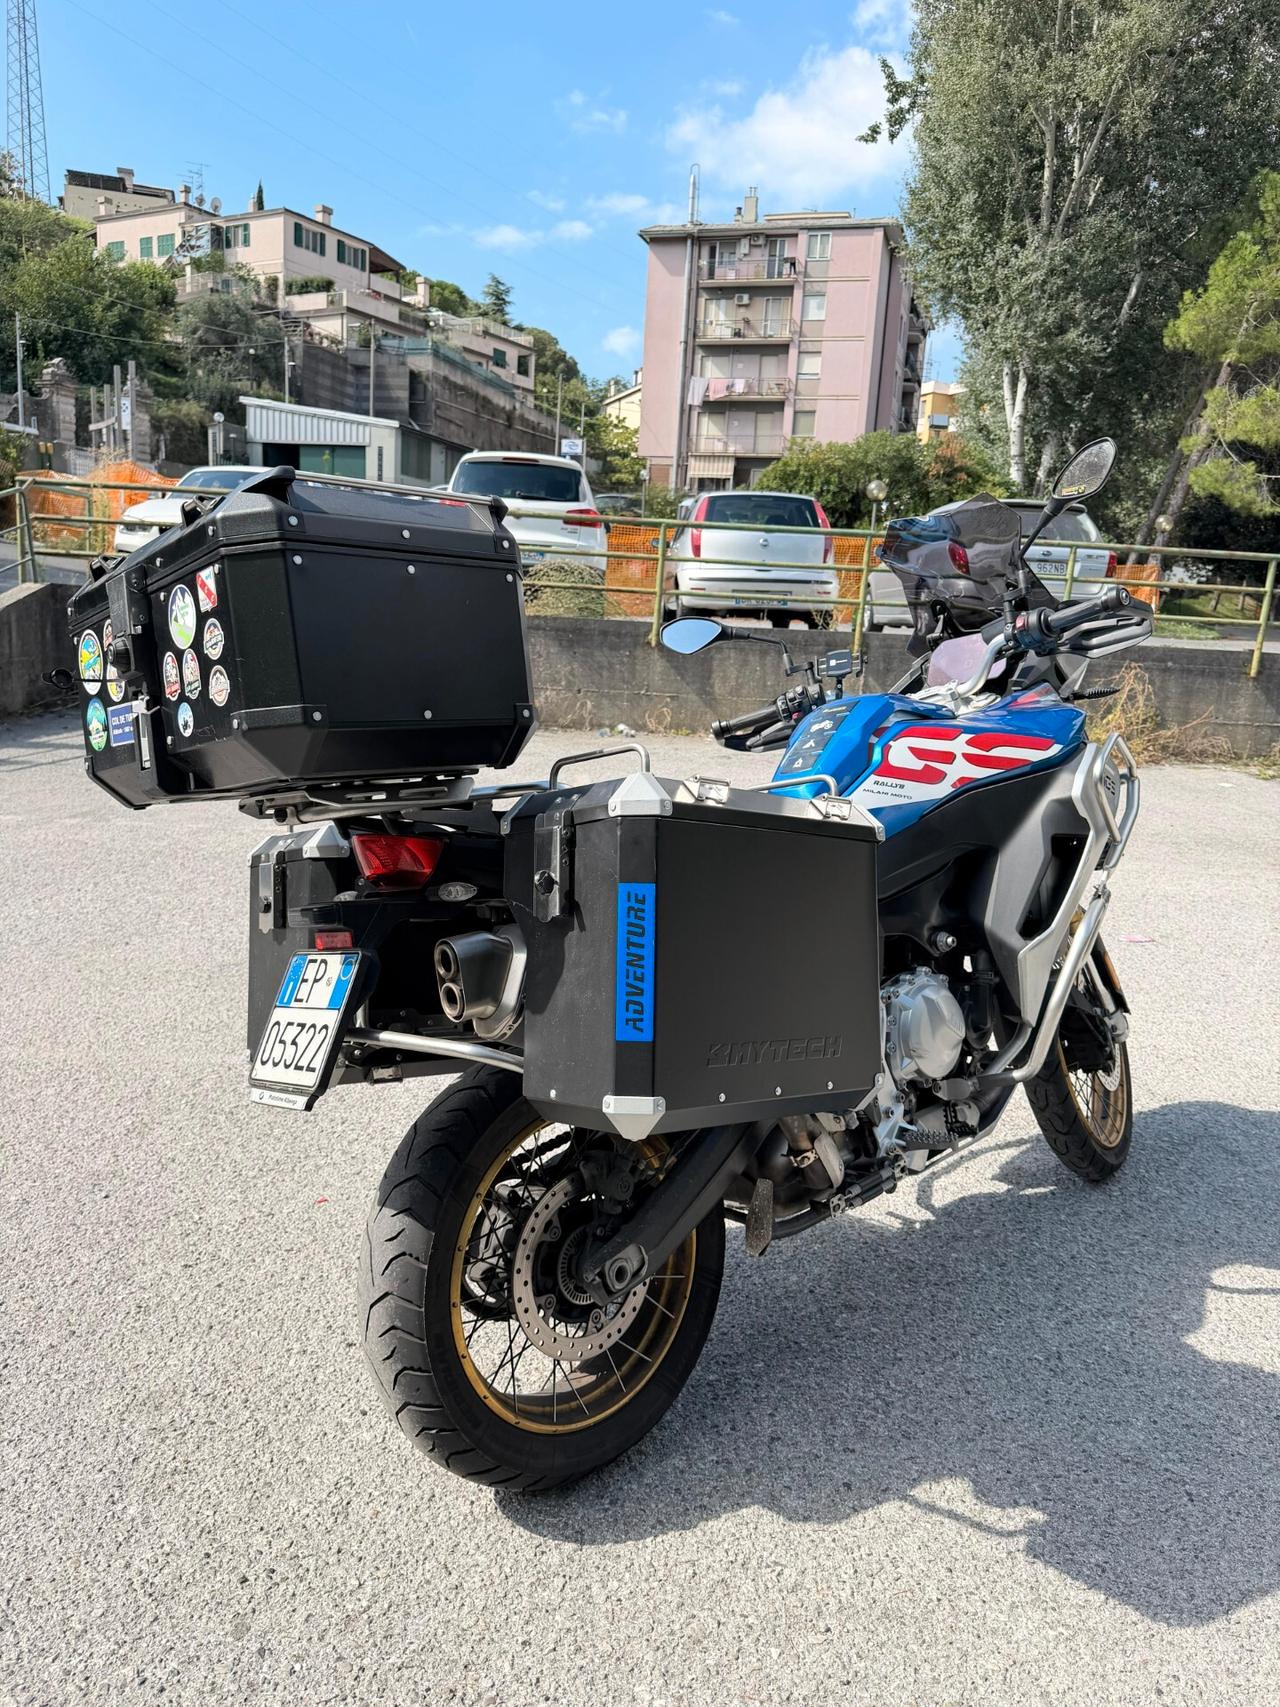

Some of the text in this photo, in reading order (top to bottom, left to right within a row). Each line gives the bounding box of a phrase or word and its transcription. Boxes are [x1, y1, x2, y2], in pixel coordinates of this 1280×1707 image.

[873, 726, 1056, 789] GS
[294, 958, 328, 1004] EP
[625, 891, 646, 1033] ADVENTURE
[260, 1020, 329, 1073] 05322
